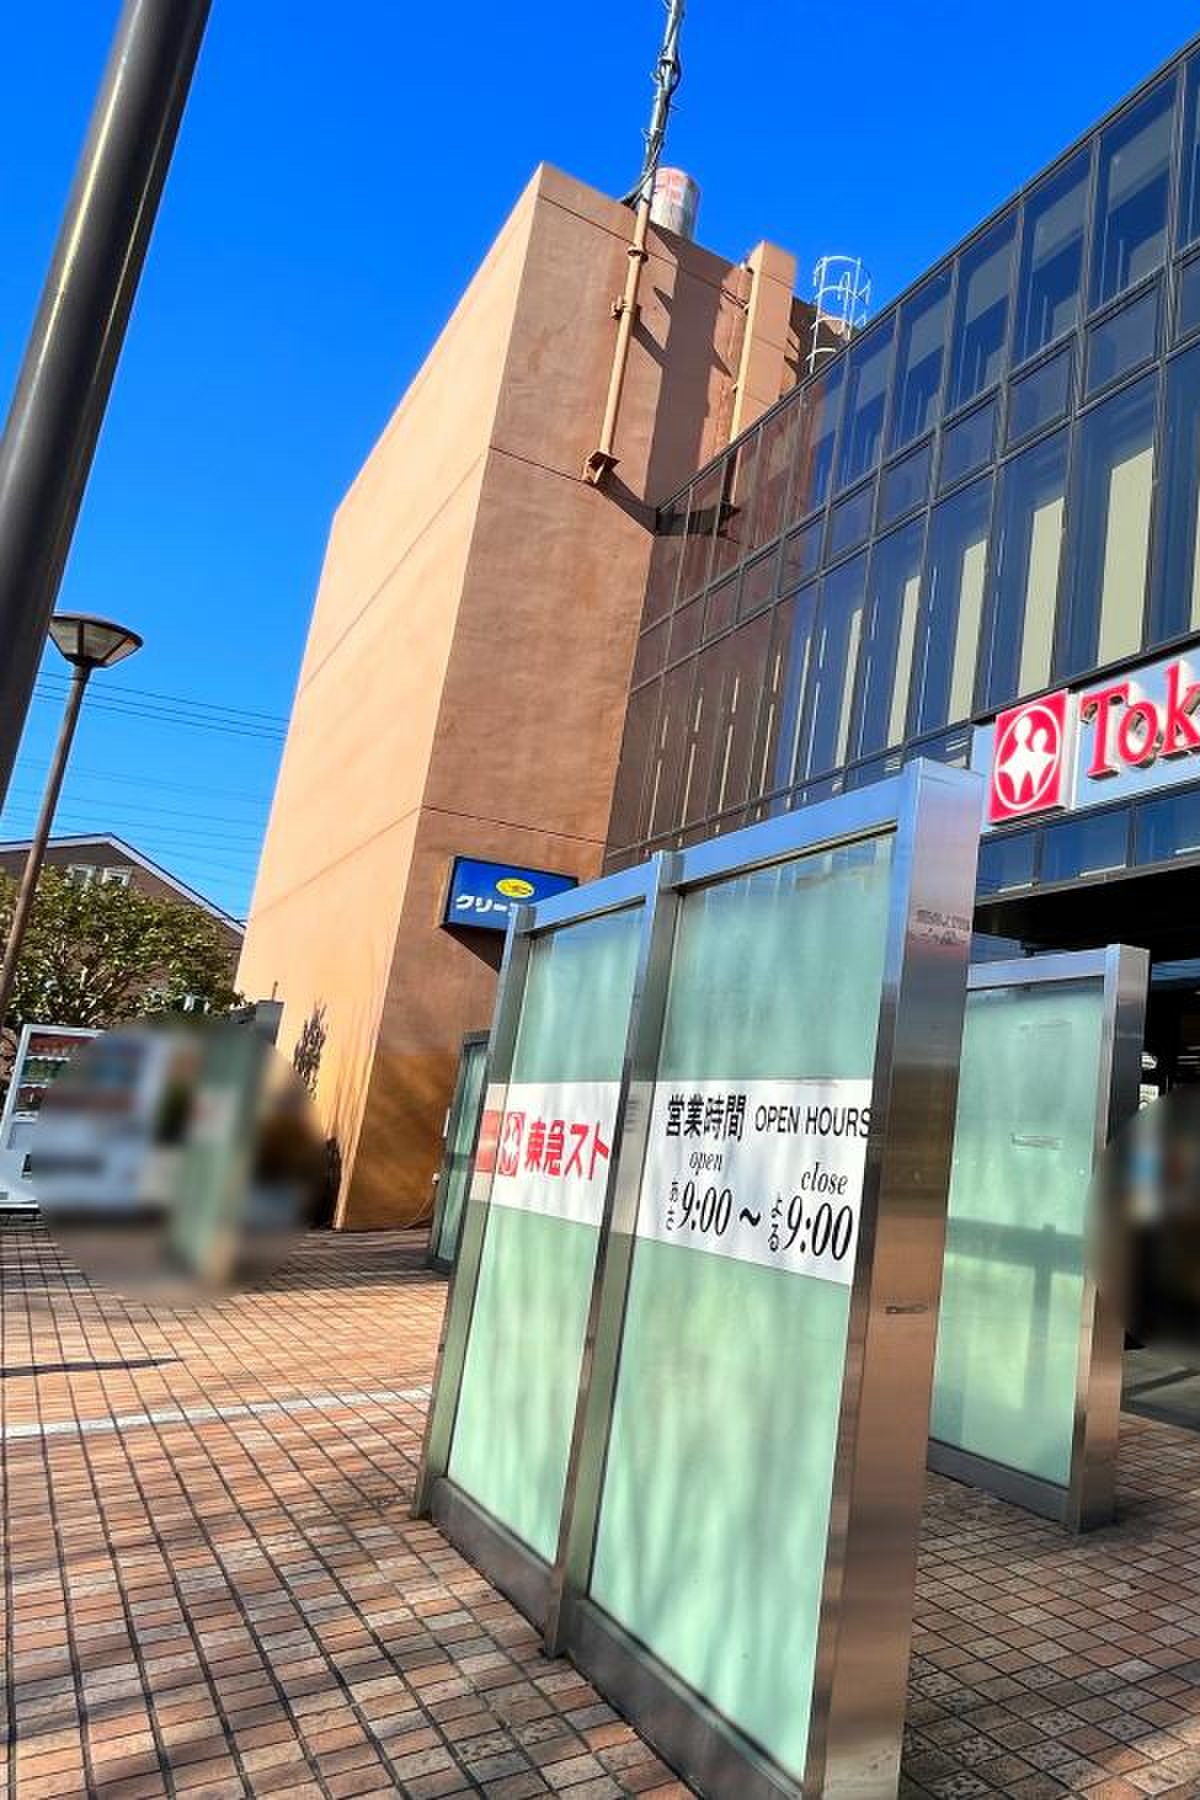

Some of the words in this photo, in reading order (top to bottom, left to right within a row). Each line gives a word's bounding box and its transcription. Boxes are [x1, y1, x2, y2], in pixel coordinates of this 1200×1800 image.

[456, 894, 510, 914] クリー
[665, 1094, 747, 1142] 営業時間
[755, 1106, 799, 1136] OPEN
[805, 1107, 871, 1138] HOURS
[524, 1119, 610, 1181] 東急スト
[688, 1151, 723, 1175] open
[800, 1160, 848, 1195] close
[678, 1181, 732, 1237] 9:00
[767, 1192, 784, 1252] よる
[783, 1195, 853, 1260] 9:00
